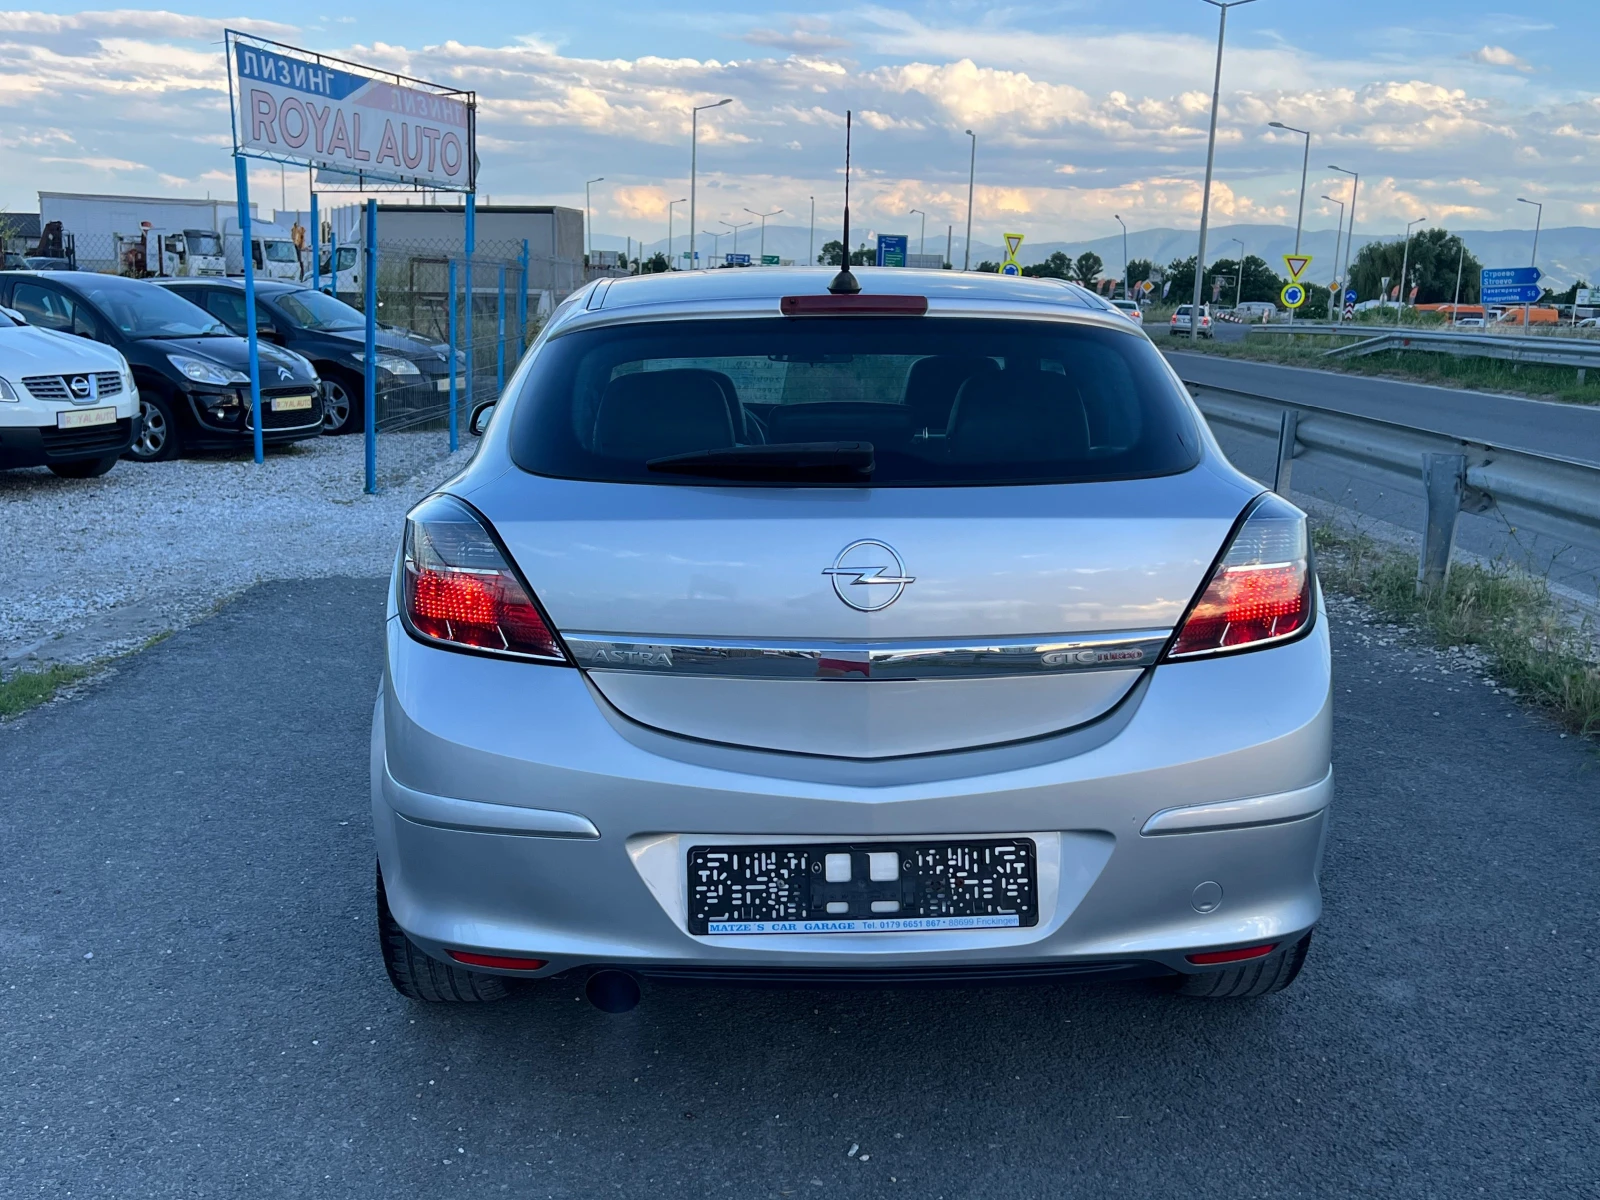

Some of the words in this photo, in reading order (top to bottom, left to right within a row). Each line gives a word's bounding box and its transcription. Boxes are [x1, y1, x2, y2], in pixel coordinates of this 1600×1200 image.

[243, 51, 335, 95] ЛИЗИНГ
[251, 88, 371, 161] ROYAL
[376, 119, 462, 176] AUTO
[1484, 270, 1515, 278] Строево
[593, 649, 673, 667] ASTRA
[1041, 649, 1096, 666] GTC
[771, 922, 797, 932] CAR
[804, 922, 855, 931] GARAGE
[862, 921, 878, 930] Tel.
[879, 920, 901, 930] 0179
[903, 919, 923, 928] 6651
[925, 919, 942, 928] 867
